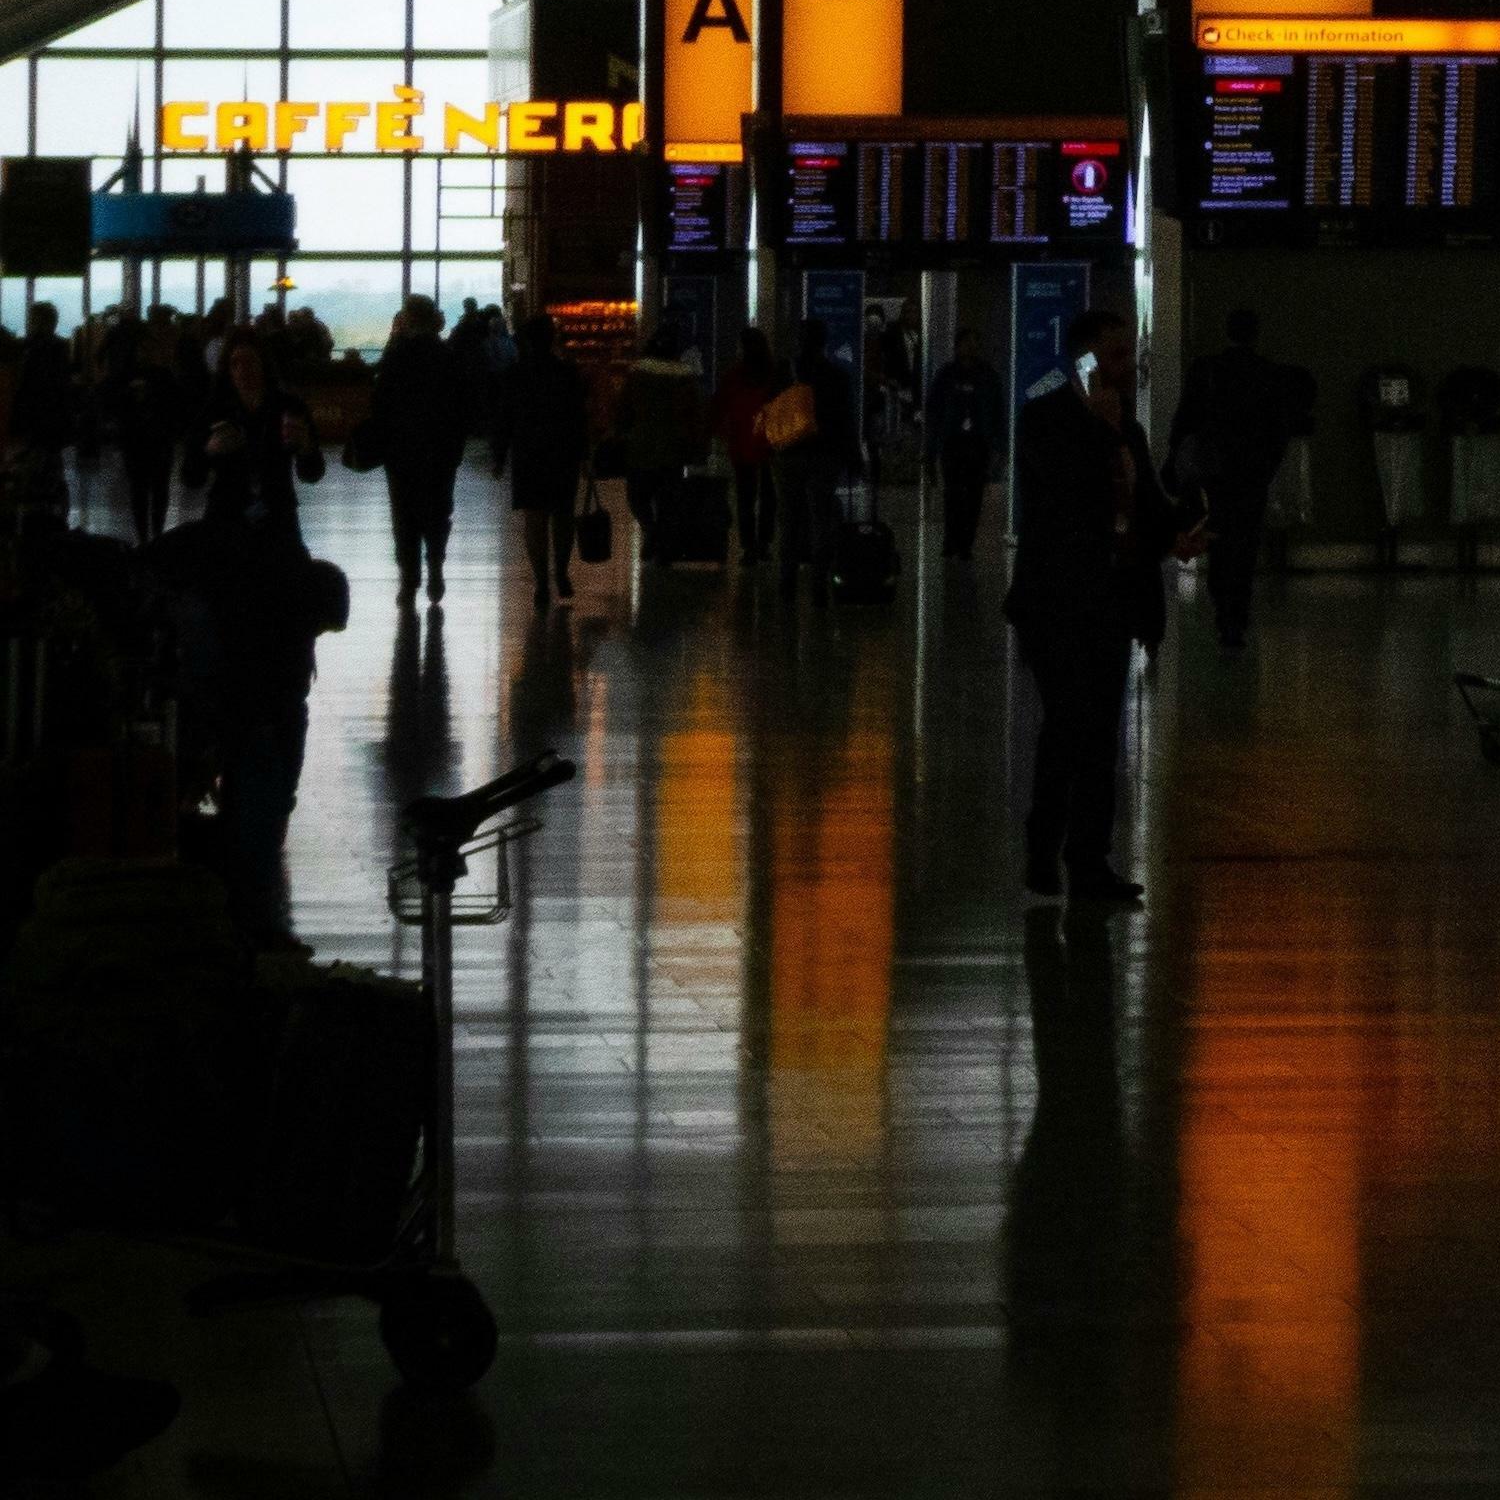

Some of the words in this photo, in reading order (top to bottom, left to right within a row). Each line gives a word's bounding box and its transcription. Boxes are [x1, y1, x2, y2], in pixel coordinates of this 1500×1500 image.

[1225, 28, 1299, 42] Check-in
[1304, 28, 1405, 42] information
[162, 84, 424, 154] CAFFÈ
